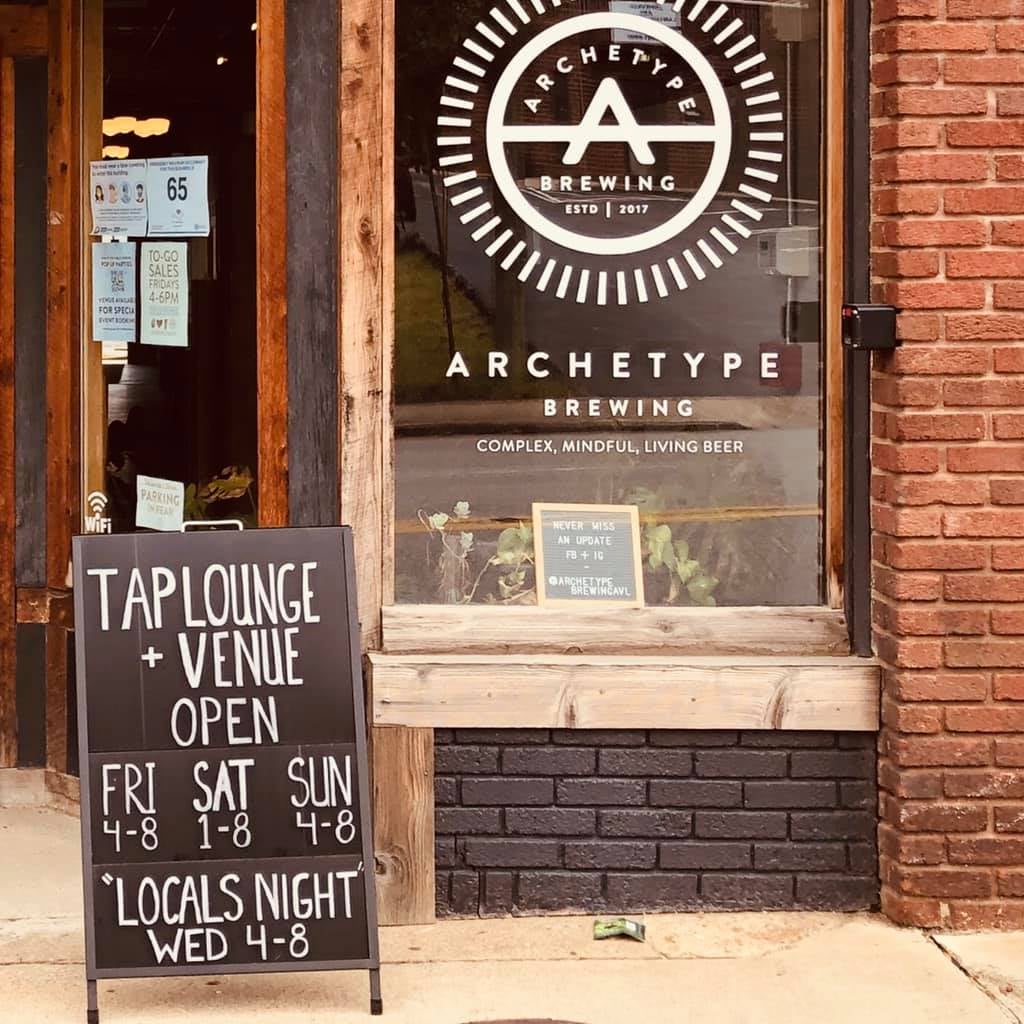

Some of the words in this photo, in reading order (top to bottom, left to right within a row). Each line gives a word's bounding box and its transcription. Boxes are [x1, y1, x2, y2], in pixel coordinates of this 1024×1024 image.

[523, 44, 697, 114] ARCHETYPE
[167, 176, 188, 201] 65
[540, 175, 675, 192] BREWING
[565, 204, 598, 215] ESTD
[619, 204, 648, 215] 2017
[148, 249, 179, 263] TO-GO
[148, 263, 180, 278] SALES
[148, 278, 180, 290] FRIDAYS
[148, 291, 179, 305] 4-6PM
[98, 306, 112, 314] FOR
[445, 351, 780, 378] ARCHETYPE
[543, 398, 694, 417] BREWING
[476, 439, 558, 455] COMPLEX,
[562, 439, 640, 456] MINDFUL,
[644, 439, 698, 454] LIVING
[703, 439, 744, 454] BEER
[141, 487, 180, 506] PARKING
[84, 513, 112, 534] WiFi
[552, 520, 584, 531] NEVER
[592, 521, 616, 531] MISS
[557, 535, 570, 545] AN
[576, 535, 612, 546] UPDATE
[565, 550, 577, 560] FB
[87, 566, 177, 630] TAP
[181, 561, 321, 628] LOUNGE
[177, 627, 304, 689] VENUE
[170, 695, 280, 747] OPEN
[102, 761, 157, 816] FRI
[192, 758, 255, 812] SAT
[287, 755, 353, 808] SUN
[103, 817, 159, 852] 4-8
[197, 812, 252, 850] 1-8
[296, 809, 356, 845] 4-8
[147, 927, 229, 964] WED
[246, 923, 310, 961] 4-8
